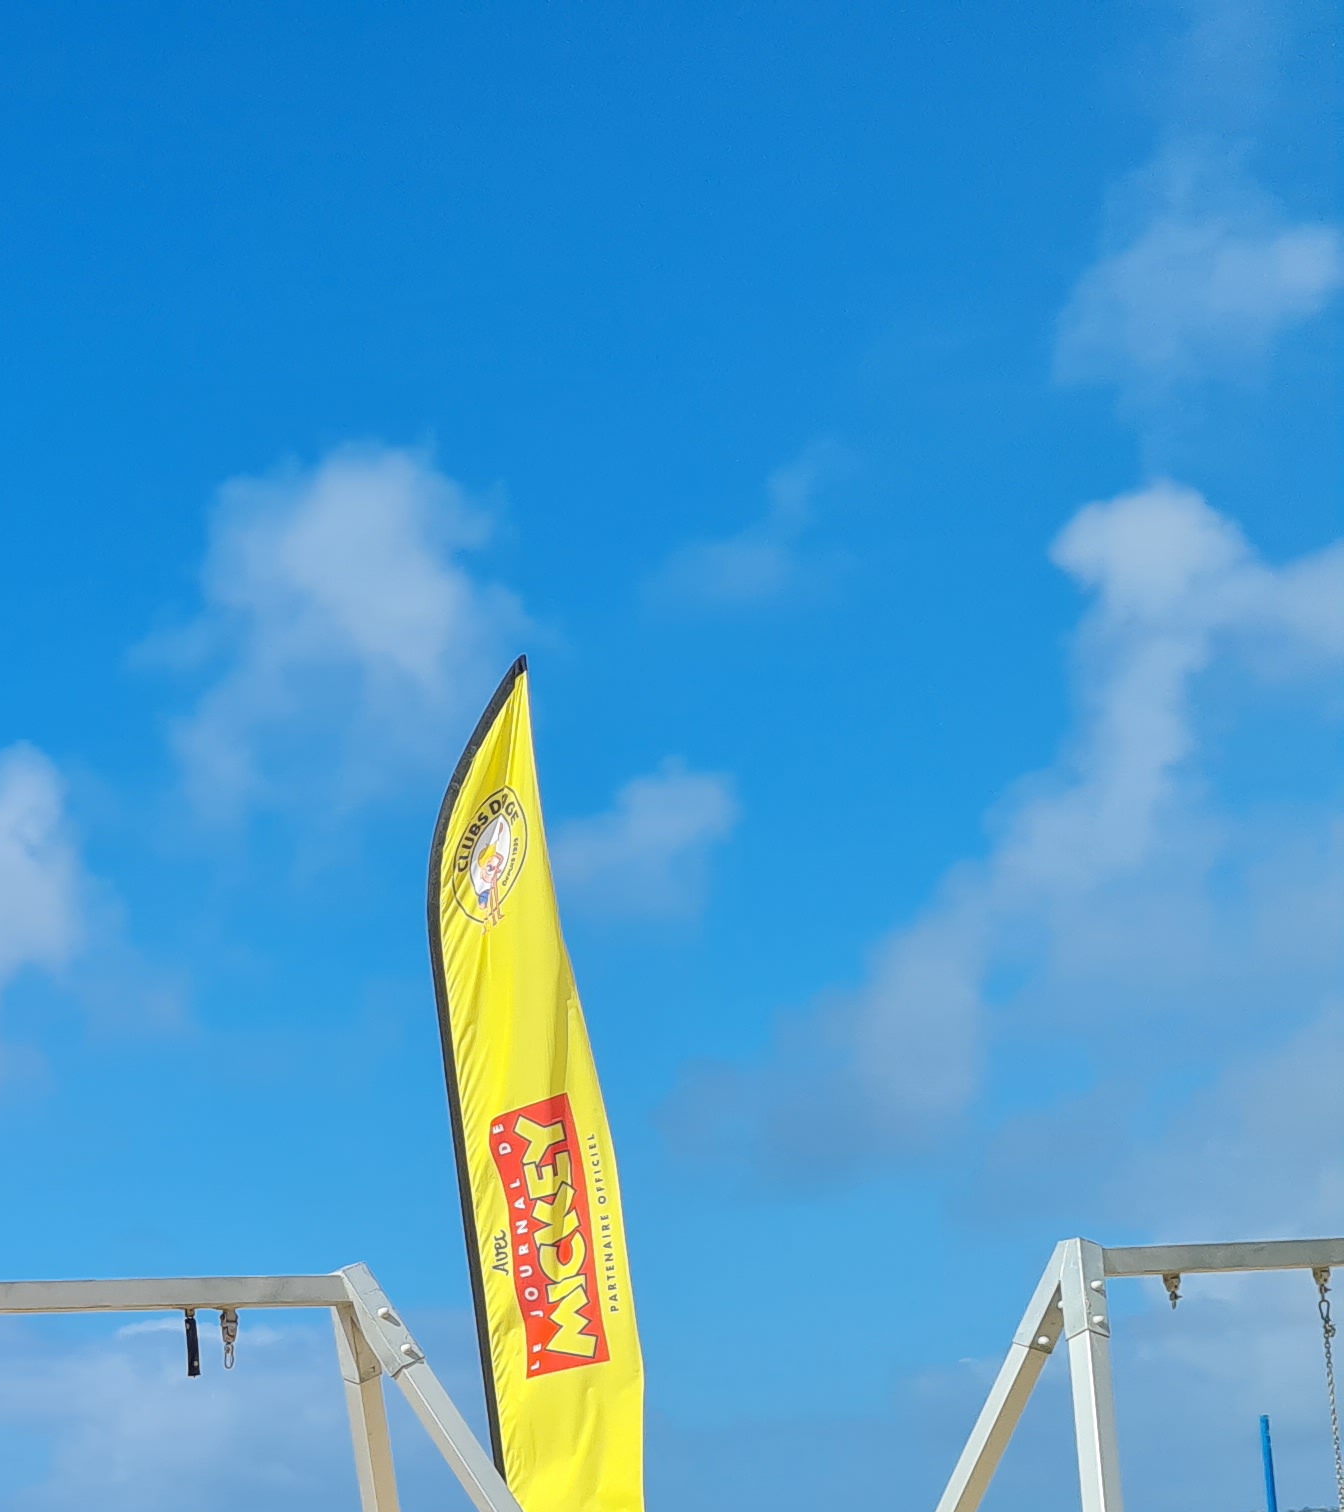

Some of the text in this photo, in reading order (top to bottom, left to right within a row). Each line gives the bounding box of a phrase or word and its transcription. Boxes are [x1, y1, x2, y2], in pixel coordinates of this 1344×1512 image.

[457, 811, 489, 873] CLUBS
[492, 1122, 544, 1371] LE JOURNAL DE
[513, 1115, 599, 1359] MICKEY
[587, 1133, 620, 1312] PARTENAIRE OFFICIEL
